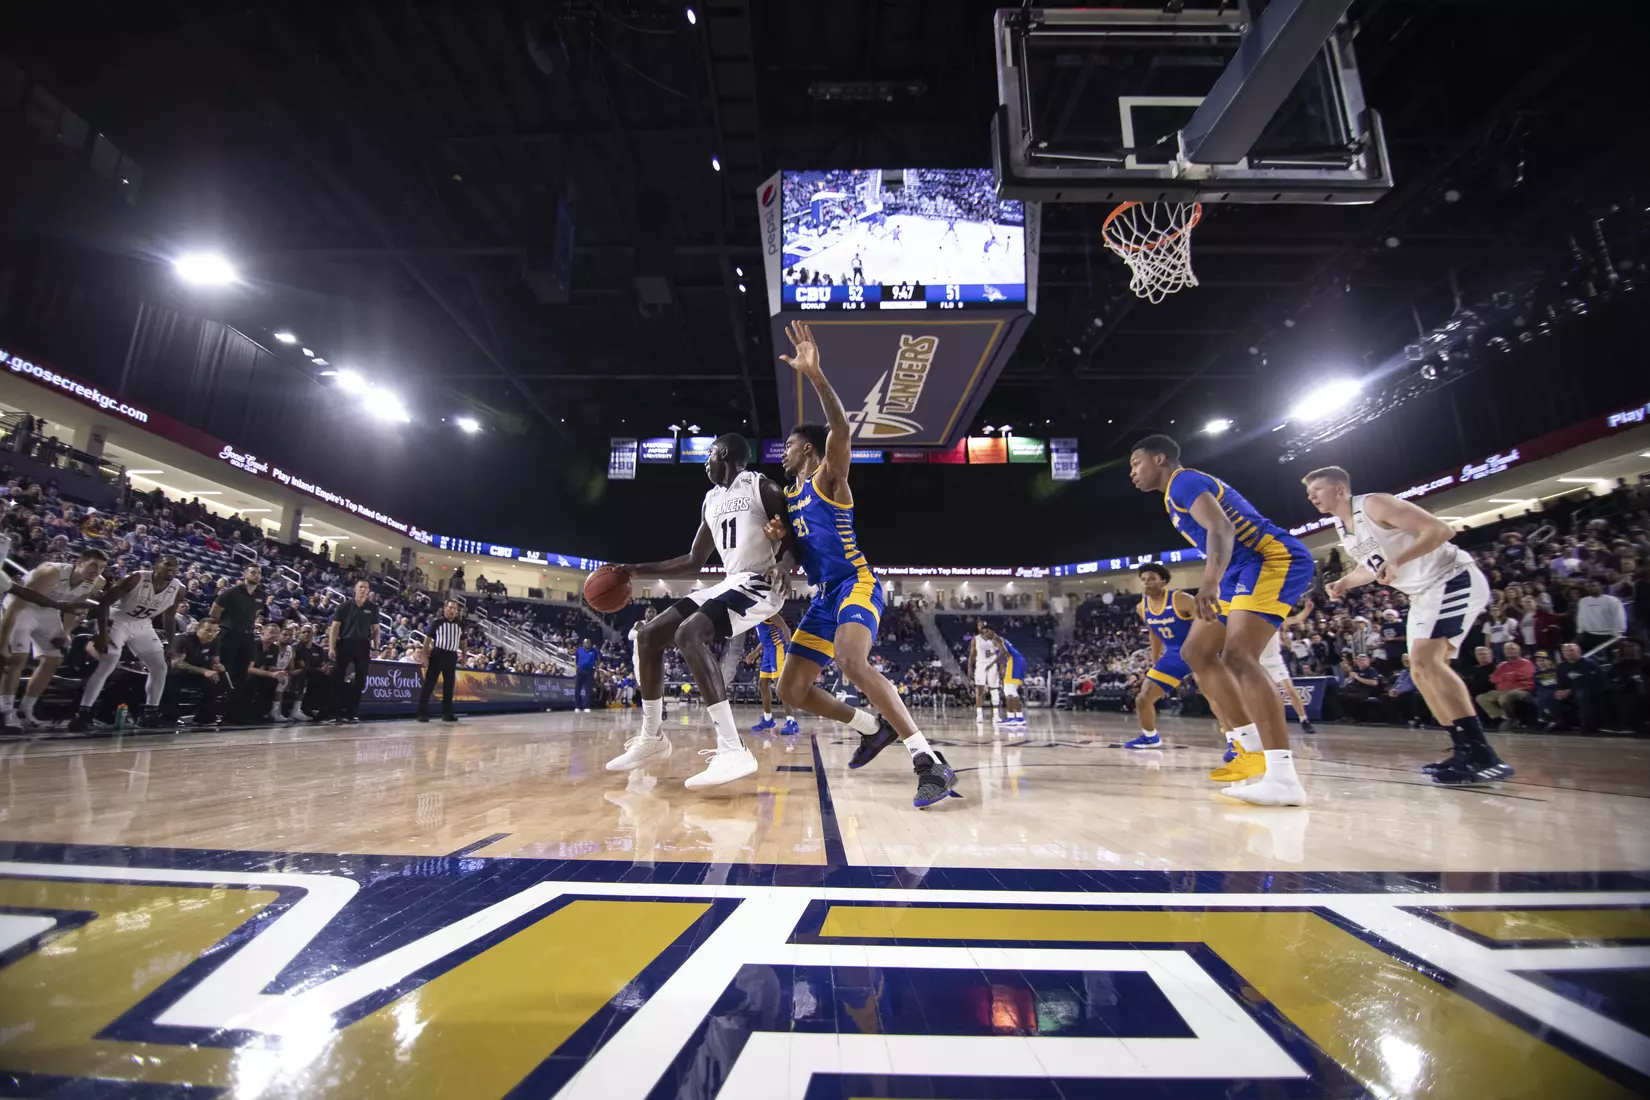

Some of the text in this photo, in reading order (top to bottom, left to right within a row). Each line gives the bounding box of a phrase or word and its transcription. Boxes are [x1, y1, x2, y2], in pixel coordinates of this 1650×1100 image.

[764, 208, 778, 256] pepsi
[795, 287, 831, 302] CBU
[848, 285, 864, 302] 52
[892, 285, 915, 300] 9:47
[945, 284, 960, 301] 51
[883, 334, 940, 414] LANCERS
[1606, 407, 1645, 428] Play
[272, 467, 291, 485] Play
[291, 475, 315, 494] Inland
[315, 485, 345, 506] Empire's
[345, 498, 359, 512] Top
[358, 504, 376, 519] Rated
[375, 512, 389, 524] Golf
[713, 496, 750, 518] LANCERS
[721, 516, 737, 550] 11
[490, 545, 513, 558] CBU
[1170, 551, 1182, 563] 51
[873, 567, 888, 576] Play
[1076, 562, 1098, 574] CBU
[1110, 558, 1122, 570] 52
[387, 668, 422, 689] Creek
[373, 688, 412, 698] GOLF CLUB
